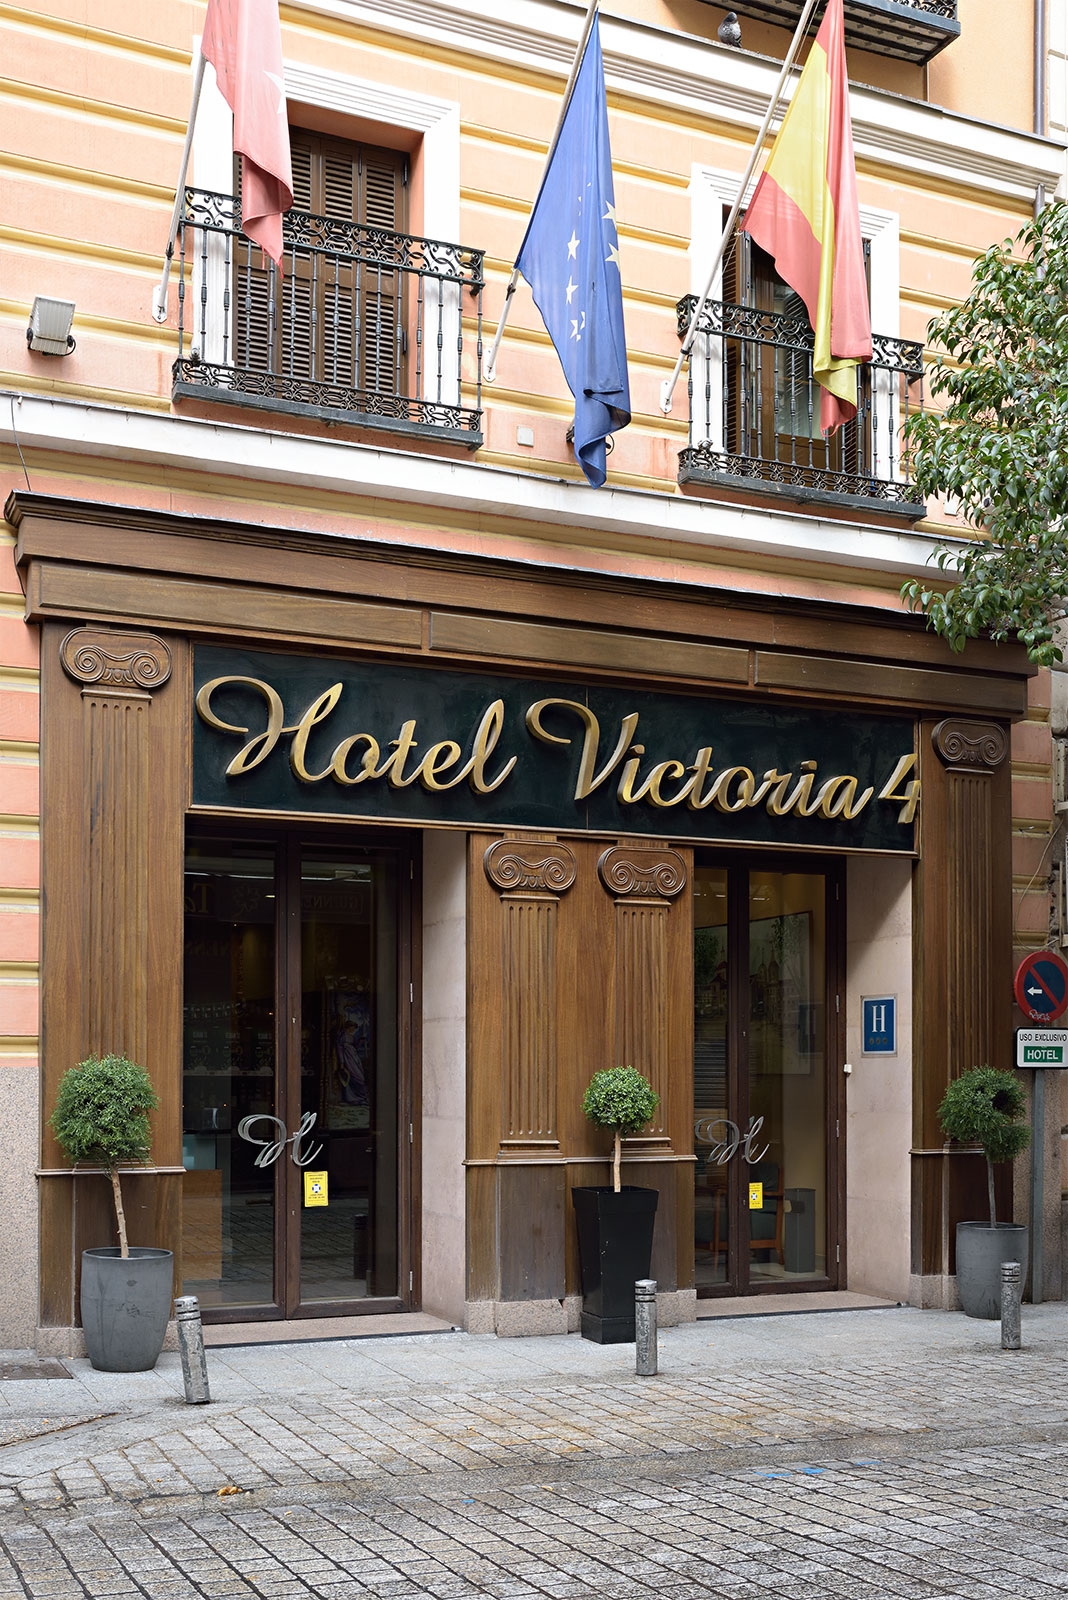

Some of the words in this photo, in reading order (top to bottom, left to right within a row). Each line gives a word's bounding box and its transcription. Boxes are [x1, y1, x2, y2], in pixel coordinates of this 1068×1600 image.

[196, 675, 518, 794] Hotel
[526, 698, 874, 820] Victoria
[879, 753, 921, 824] 4
[872, 1005, 887, 1032] H
[1019, 1033, 1032, 1042] USO
[1034, 1033, 1067, 1042] EXCLUSIVO
[1027, 1049, 1059, 1060] HOTEL
